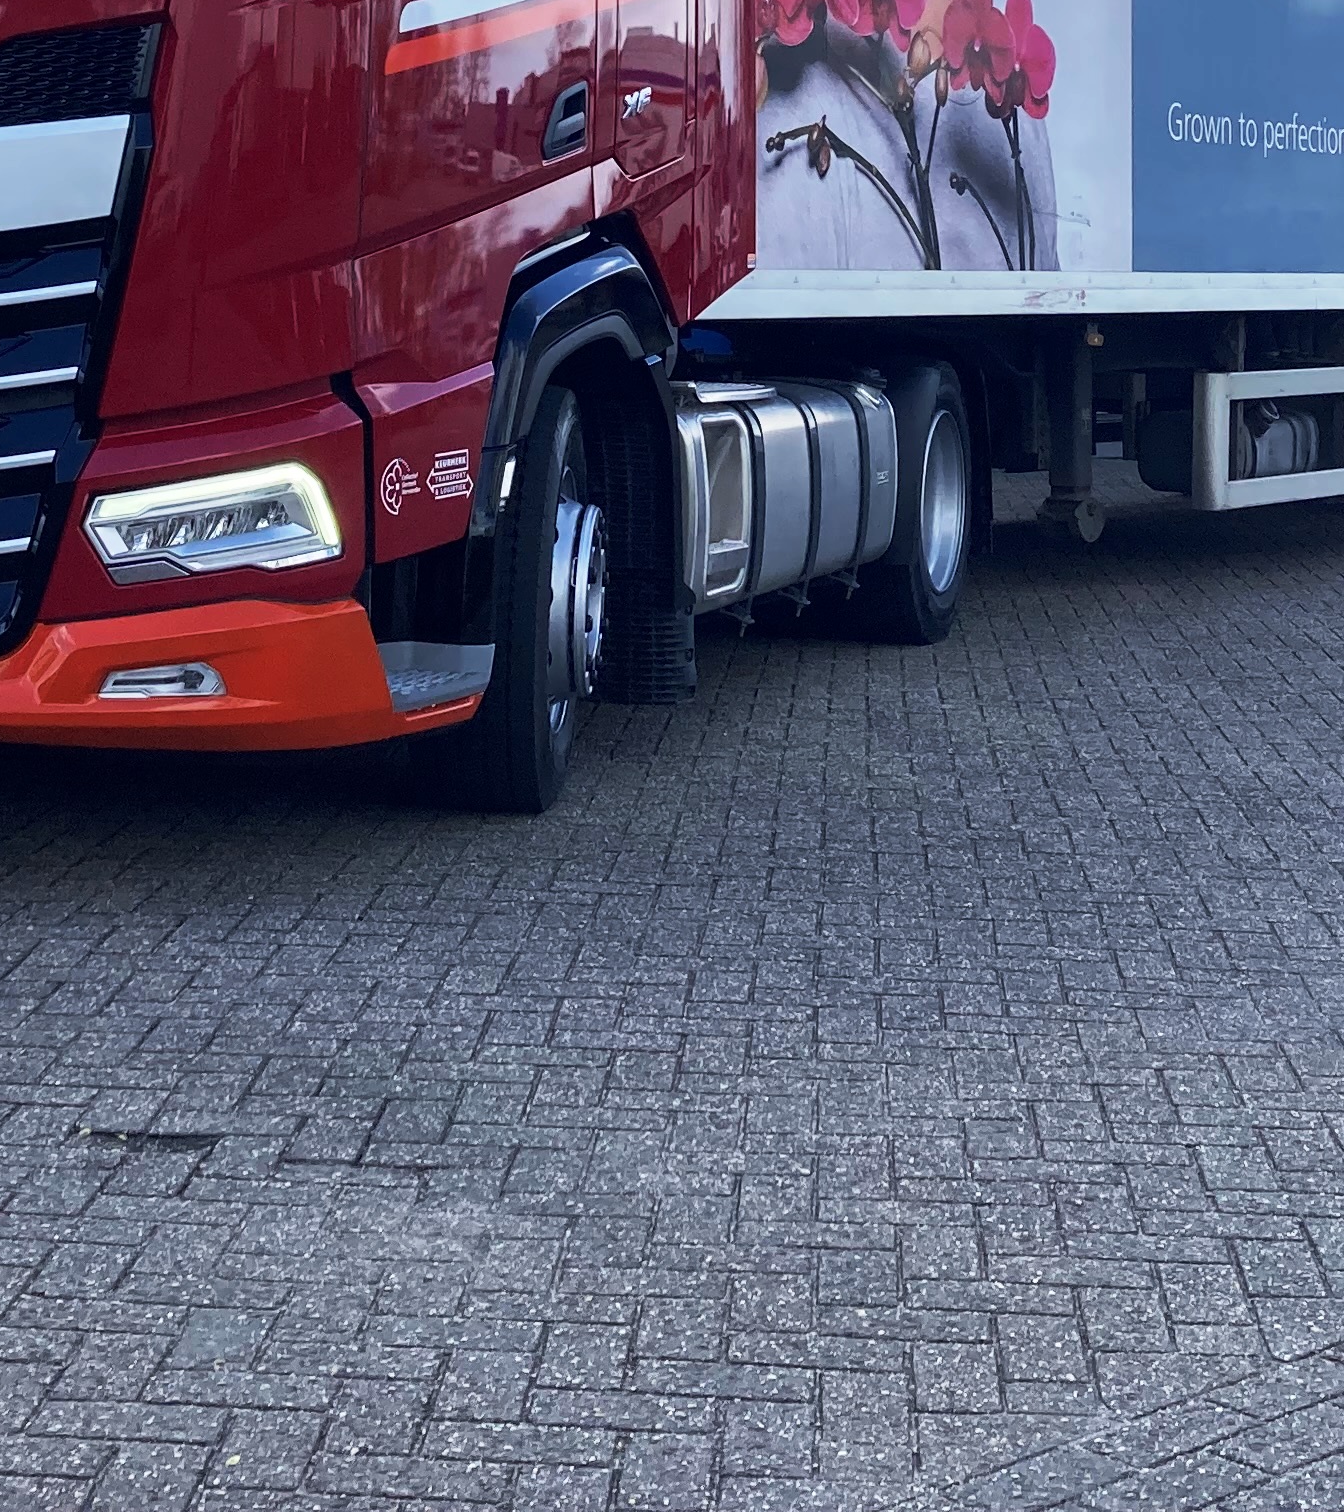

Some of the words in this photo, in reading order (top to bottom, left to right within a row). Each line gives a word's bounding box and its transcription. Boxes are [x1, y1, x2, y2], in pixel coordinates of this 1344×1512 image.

[622, 87, 652, 119] XF
[1167, 101, 1232, 145] Grown
[1238, 112, 1258, 147] to
